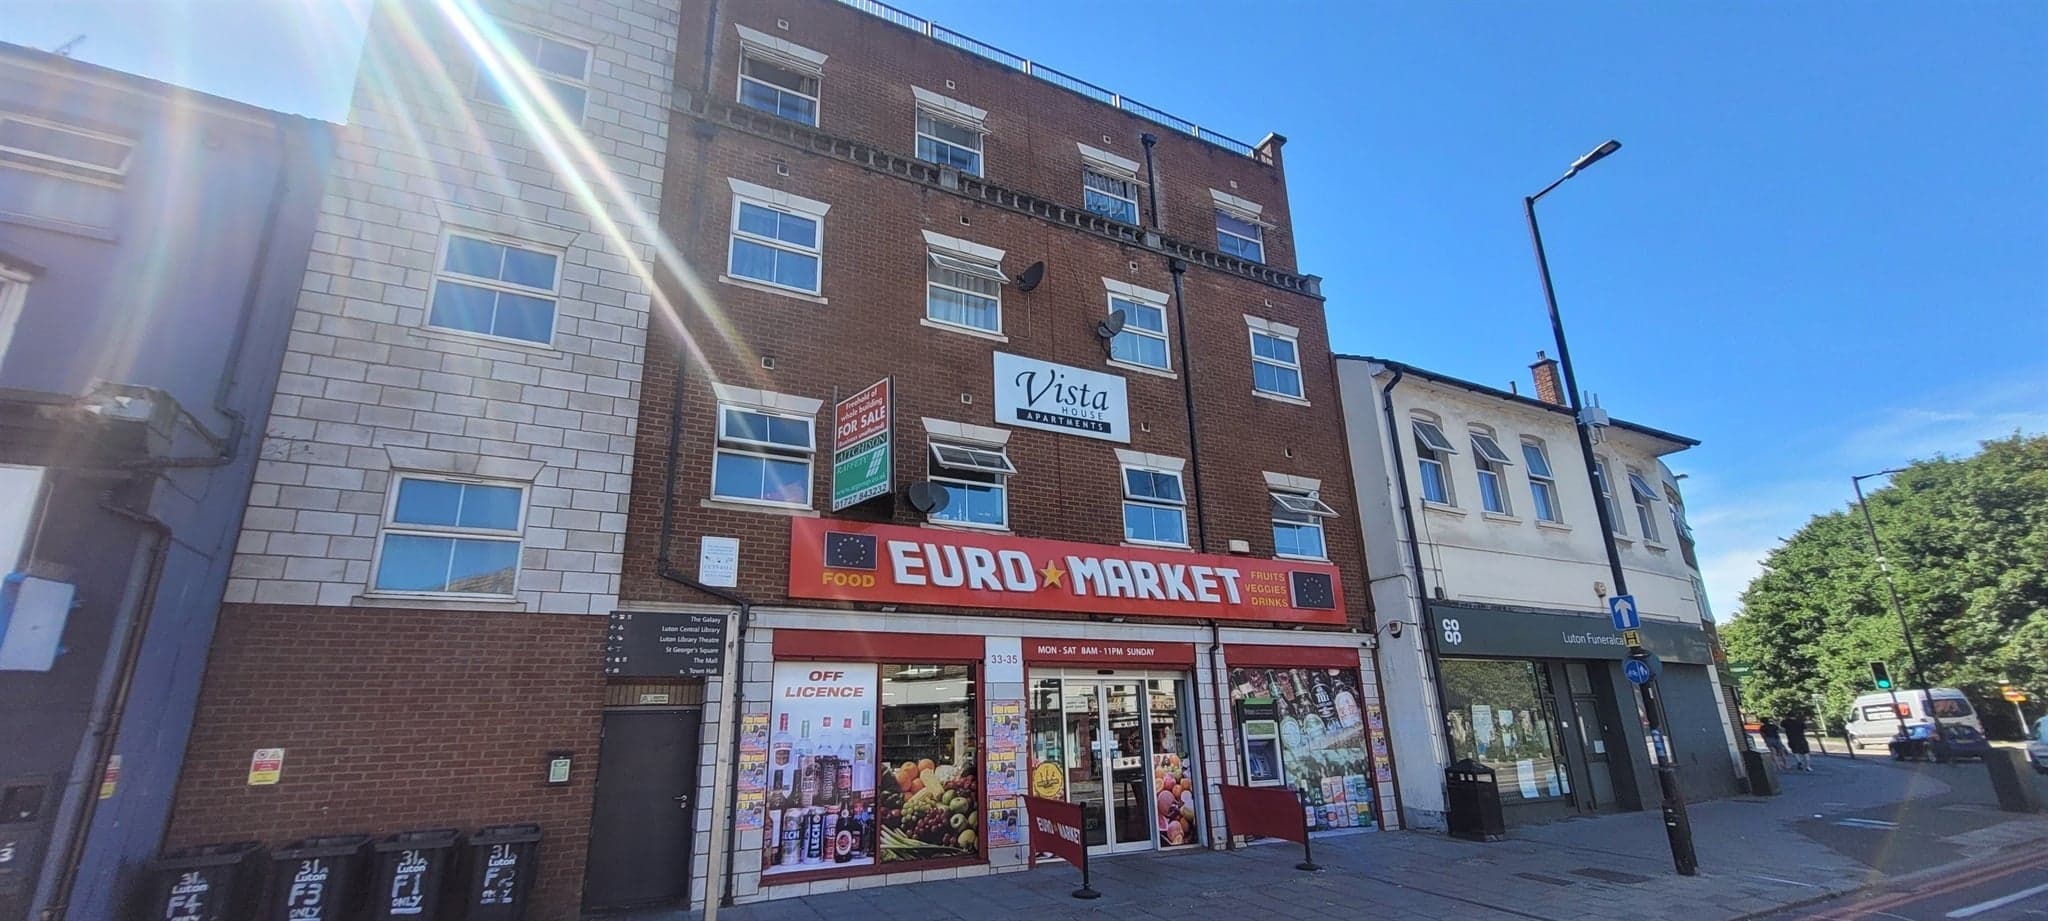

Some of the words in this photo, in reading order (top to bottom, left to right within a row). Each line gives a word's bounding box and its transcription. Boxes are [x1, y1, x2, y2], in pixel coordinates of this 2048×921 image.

[1016, 369, 1109, 411] Vista
[846, 391, 870, 410] Freehold
[871, 387, 878, 398] of
[840, 409, 858, 423] whole
[859, 397, 882, 414] building
[1061, 406, 1103, 420] HOUSE
[838, 420, 857, 440] FOR
[861, 405, 886, 428] SALE
[1026, 412, 1104, 432] APARTMENTS
[836, 434, 886, 462] AITCHISON
[837, 455, 869, 474] RAFFETY
[834, 493, 857, 510] 01727
[887, 540, 1037, 592] EURO
[1065, 555, 1241, 605] MARKET
[1250, 571, 1286, 583] FRUITS
[822, 572, 875, 588] FOOD
[1245, 583, 1287, 595] VEGGIES
[1251, 596, 1289, 608] DRINKS
[702, 616, 720, 624] Galaxy
[1442, 618, 1459, 631] co
[701, 626, 720, 634] Library
[678, 636, 698, 644] Library
[1444, 632, 1462, 645] op
[1563, 632, 1585, 645] Luton
[1586, 633, 1624, 646] Funeralca
[1625, 632, 1639, 646] H
[1038, 646, 1057, 655] MON
[1063, 646, 1077, 655] SAT
[1081, 646, 1098, 655] 8AM
[1103, 647, 1123, 656] 11PM
[1126, 648, 1155, 656] SUNDAY
[991, 655, 1018, 665] 33-35
[809, 671, 844, 682] OFF
[785, 687, 864, 698] LICENCE
[784, 830, 800, 840] ECH
[812, 824, 821, 850] LECH
[1036, 817, 1055, 836] EURO
[1057, 822, 1081, 844] MARKET
[397, 863, 426, 873] Luton
[488, 858, 515, 867] Luton
[294, 874, 327, 883] Luton
[172, 883, 209, 895] Luton
[391, 874, 421, 898] F1
[287, 884, 323, 907] F3
[392, 895, 423, 907] ONLY
[166, 895, 202, 919] F4
[289, 906, 322, 919] ONLY
